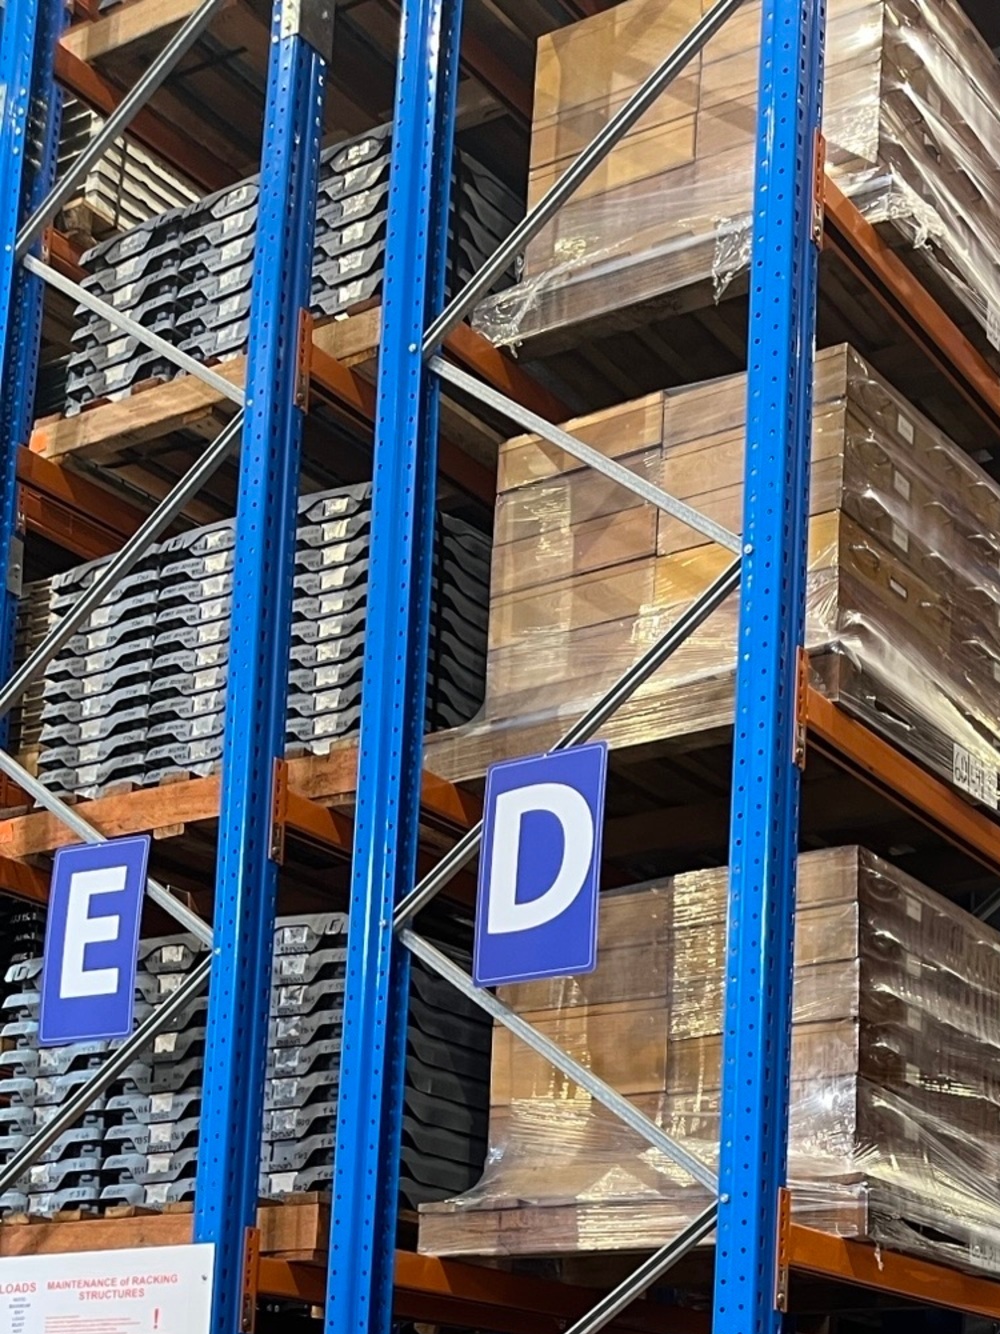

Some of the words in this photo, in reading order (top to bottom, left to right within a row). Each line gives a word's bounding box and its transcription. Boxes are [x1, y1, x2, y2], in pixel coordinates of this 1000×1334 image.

[487, 783, 594, 935] D
[59, 866, 127, 1000] E
[47, 1277, 118, 1290] MAINTENANCE
[119, 1276, 130, 1287] of
[131, 1274, 178, 1286] RACKING
[79, 1288, 145, 1301] STRUCTURES
